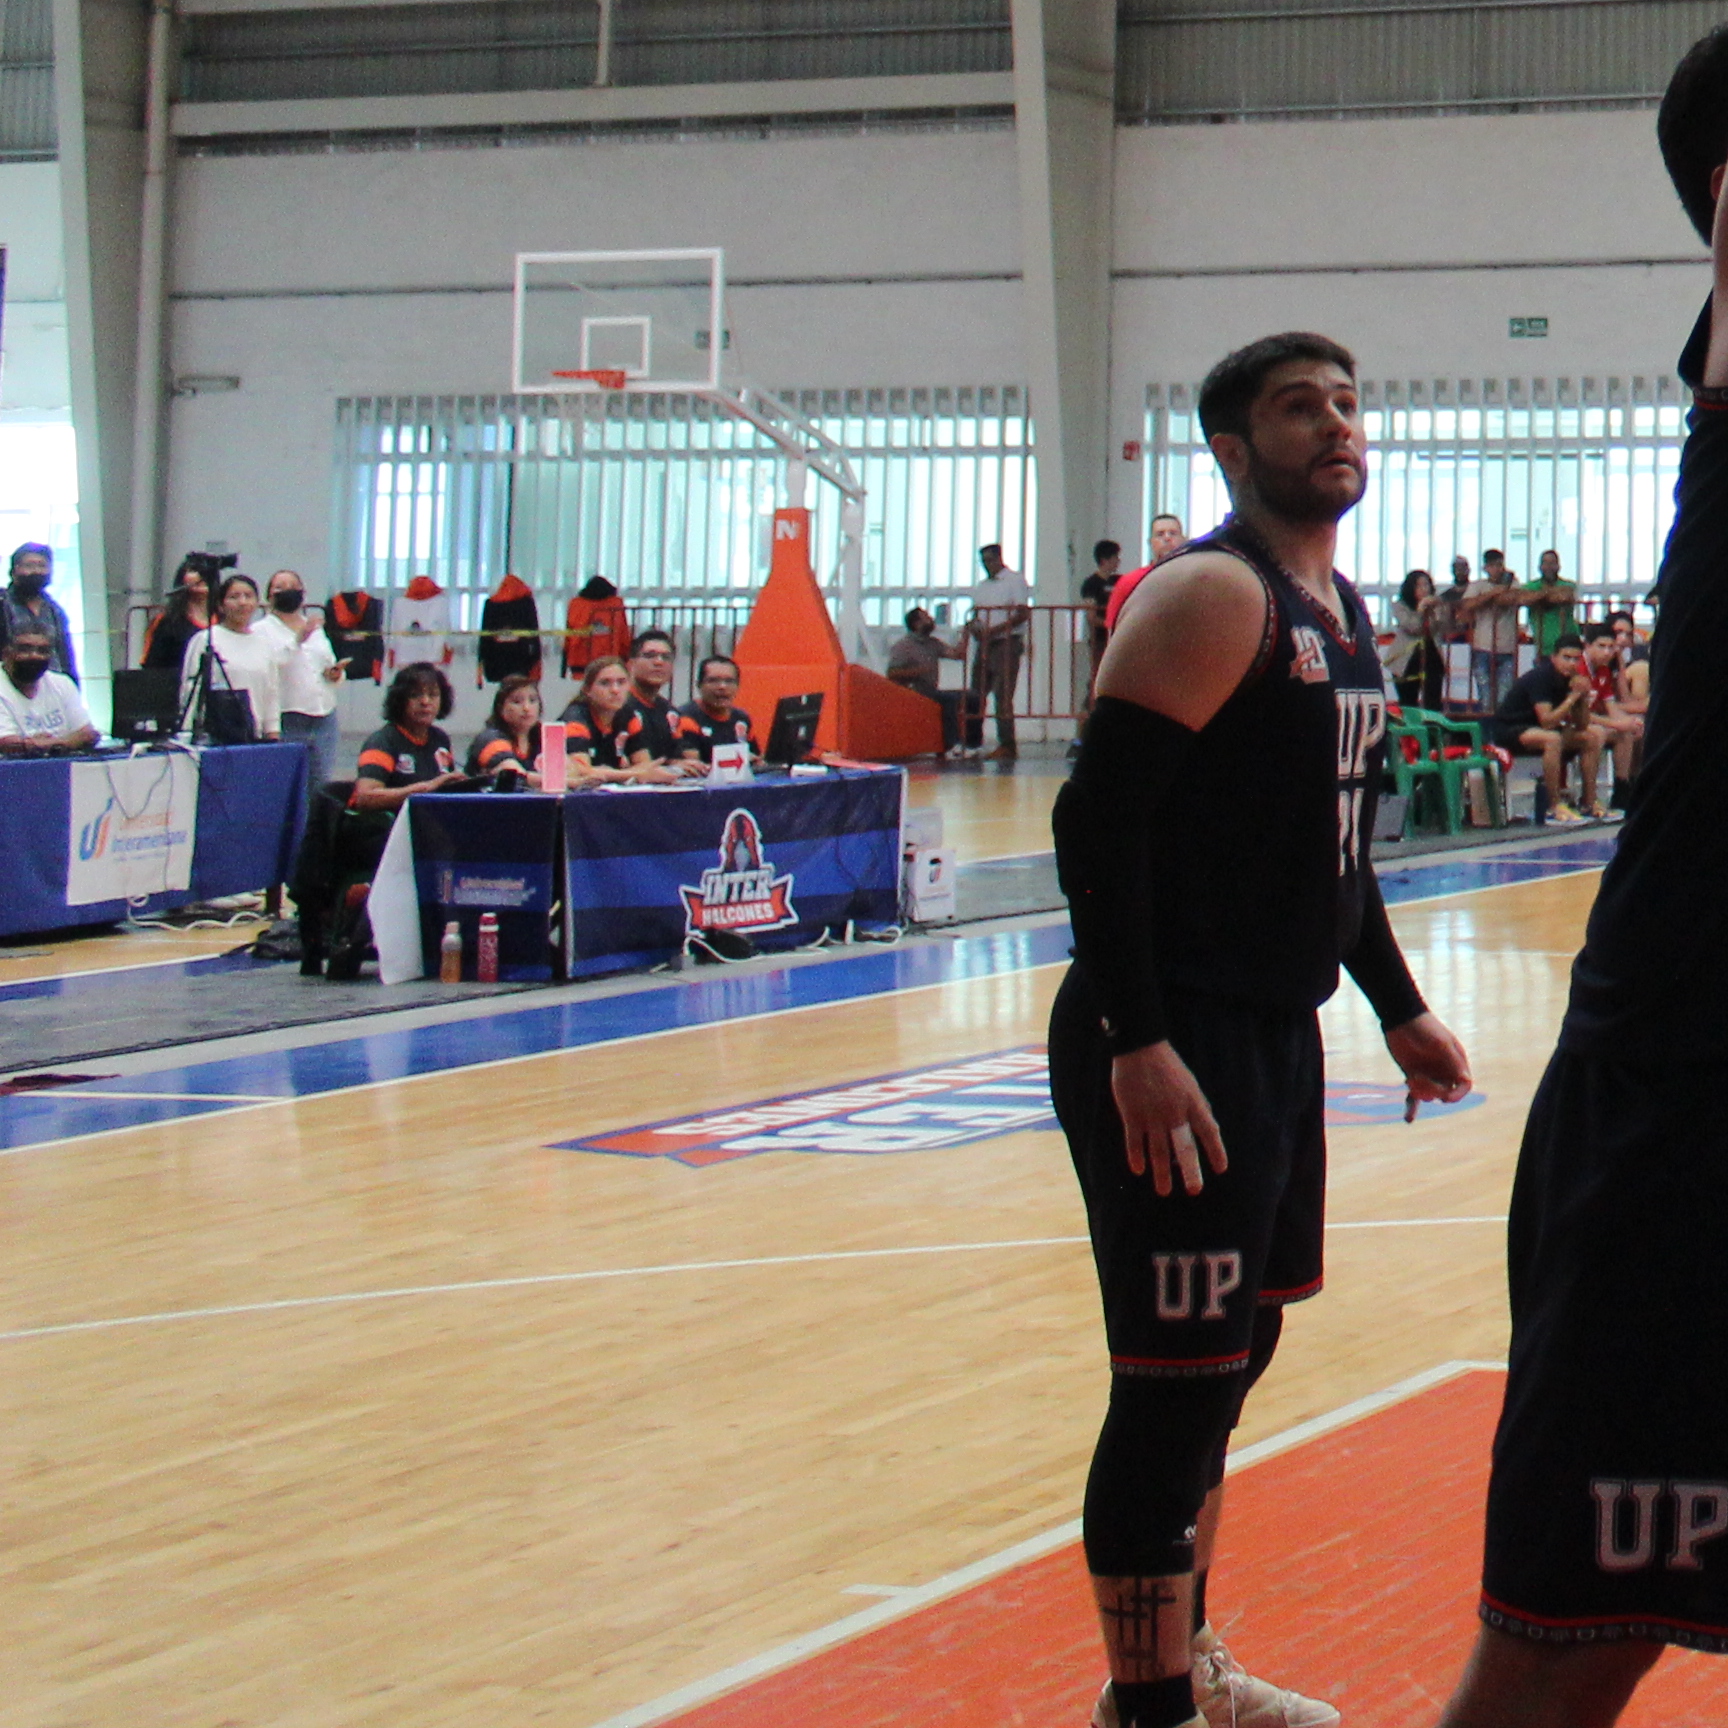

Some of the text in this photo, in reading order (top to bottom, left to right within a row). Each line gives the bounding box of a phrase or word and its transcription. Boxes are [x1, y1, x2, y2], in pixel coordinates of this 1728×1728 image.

[1335, 688, 1386, 779] UP
[702, 902, 774, 927] HALCONES
[703, 870, 772, 906] INTER
[1153, 1250, 1242, 1321] UP
